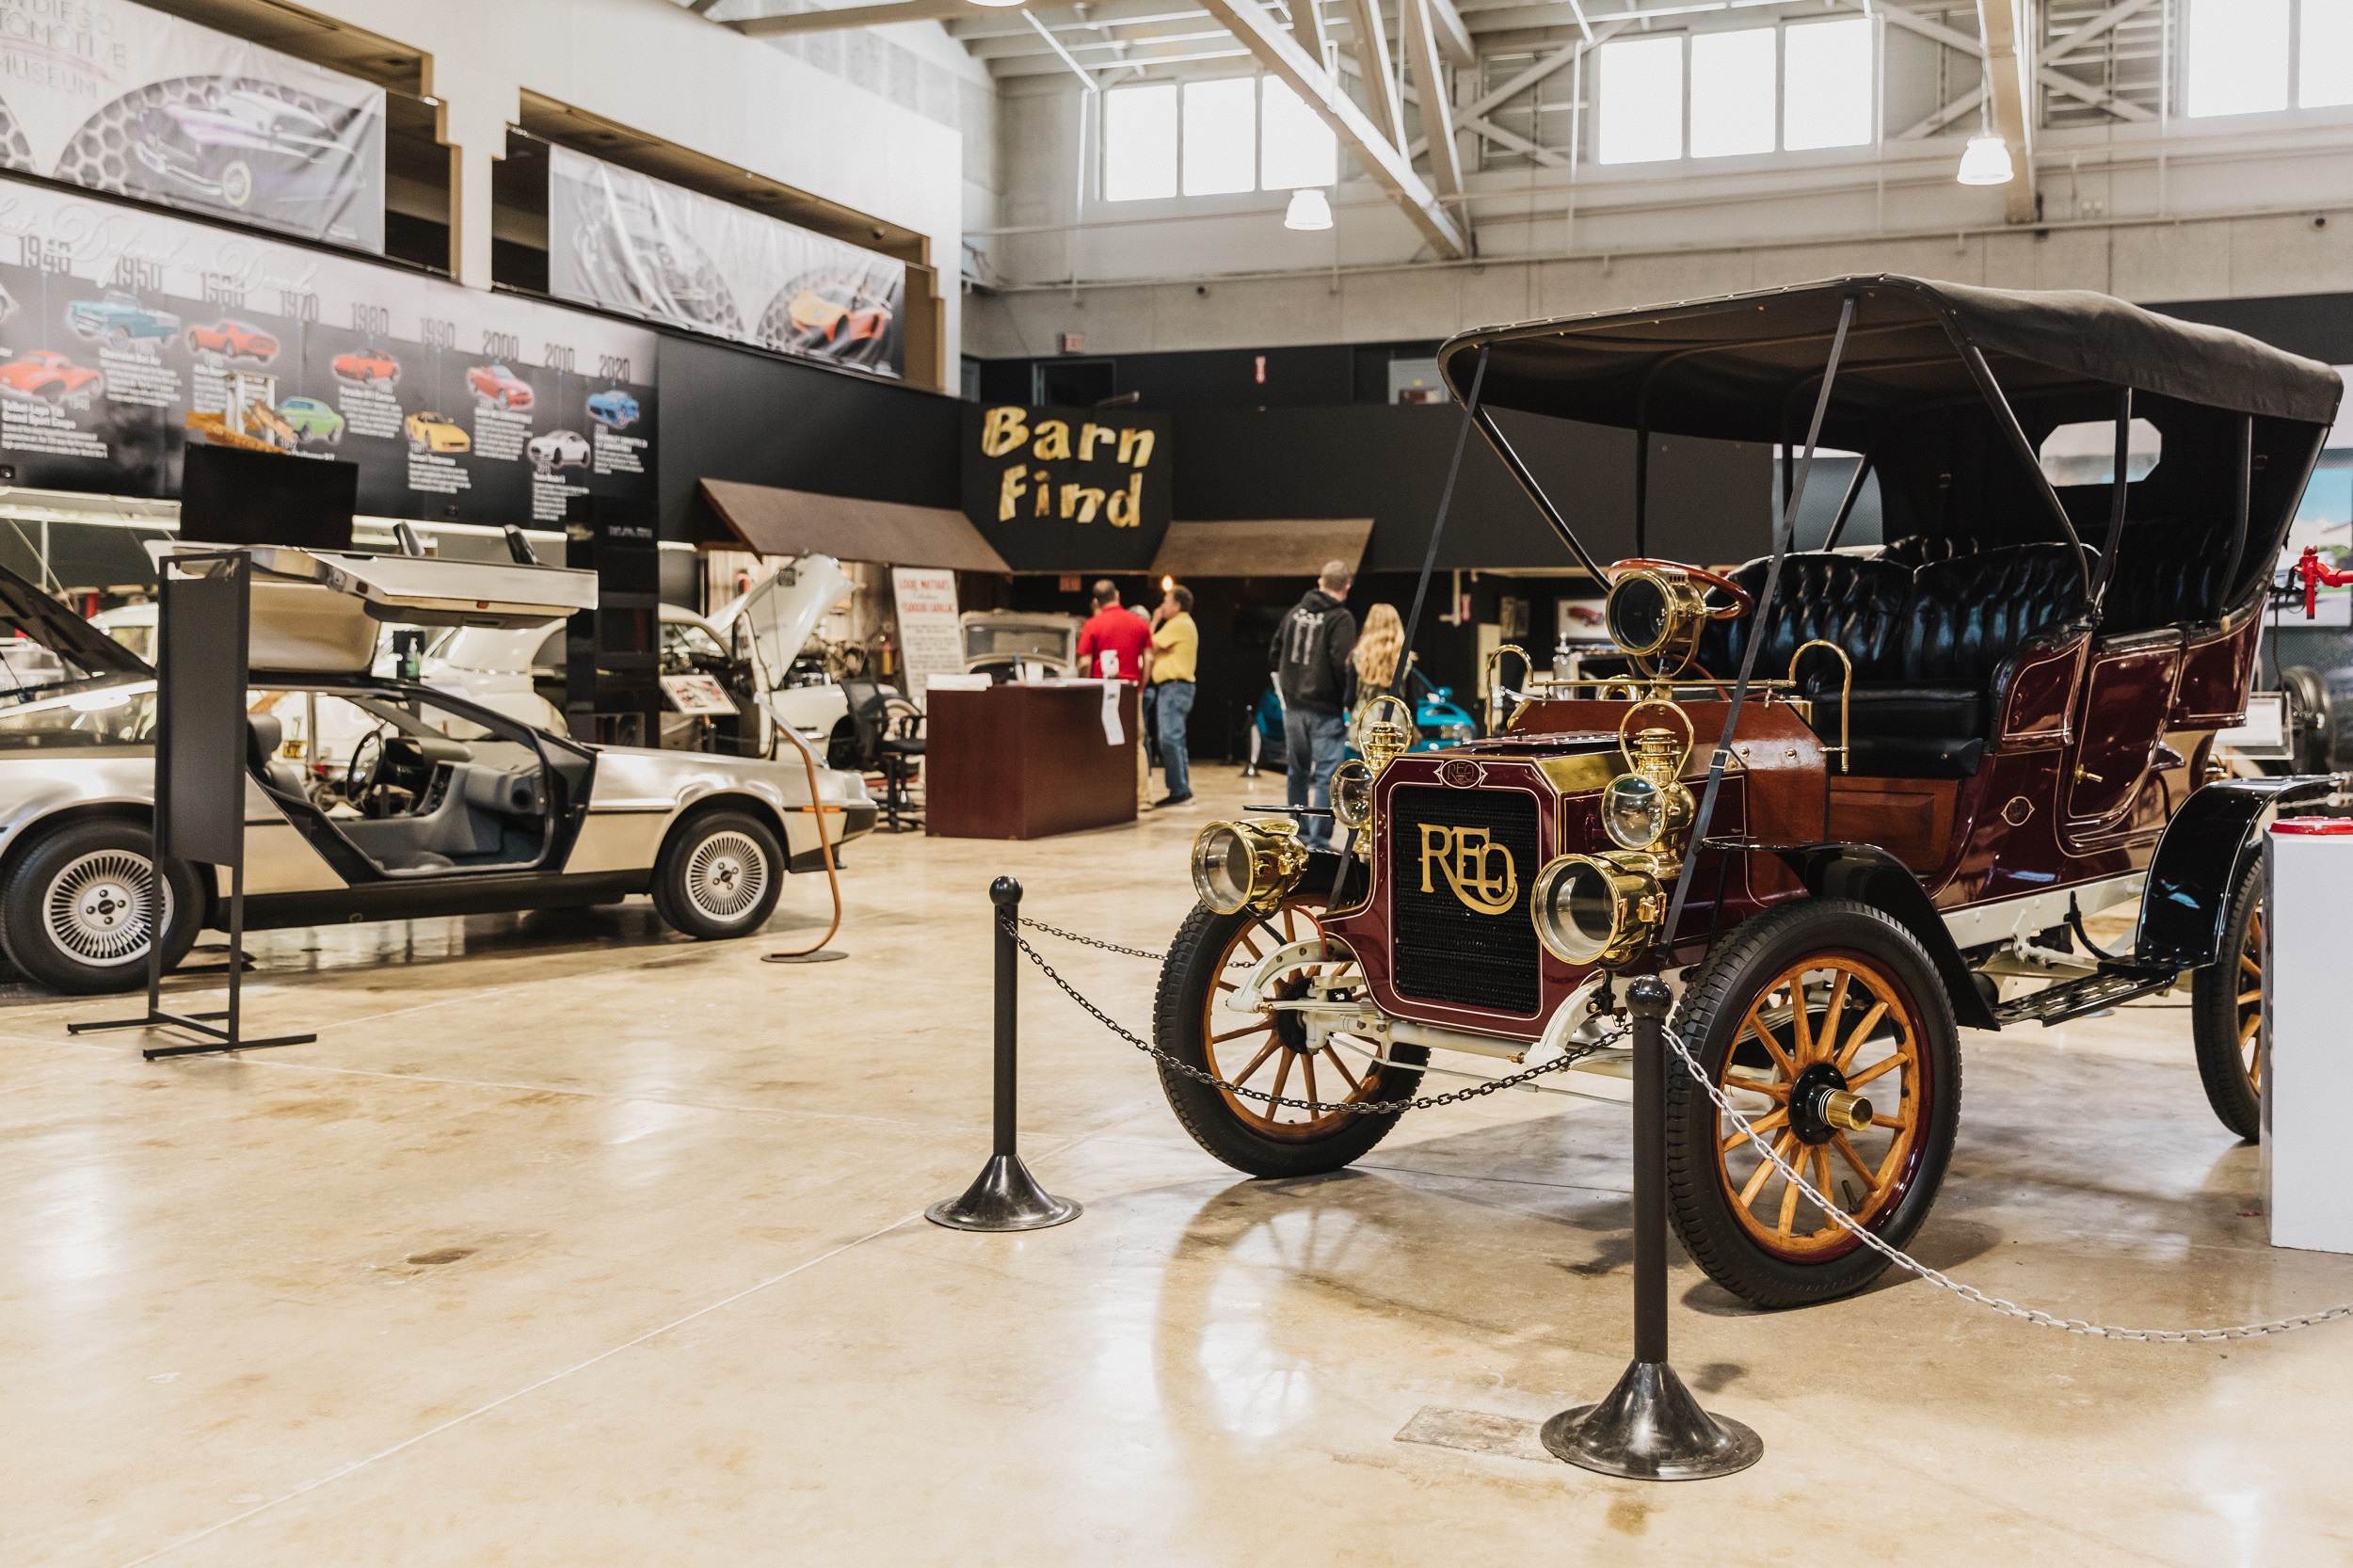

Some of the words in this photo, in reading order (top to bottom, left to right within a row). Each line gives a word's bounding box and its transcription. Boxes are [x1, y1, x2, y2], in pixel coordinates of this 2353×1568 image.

[351, 302, 391, 339] 1980
[421, 316, 456, 350] 1990
[483, 329, 520, 362] 2000
[545, 343, 576, 373] 2010
[599, 354, 632, 384] 2020
[982, 406, 1155, 468] Barn
[999, 463, 1143, 528] Find
[1447, 762, 1475, 785] REO
[1417, 823, 1518, 915] REO
